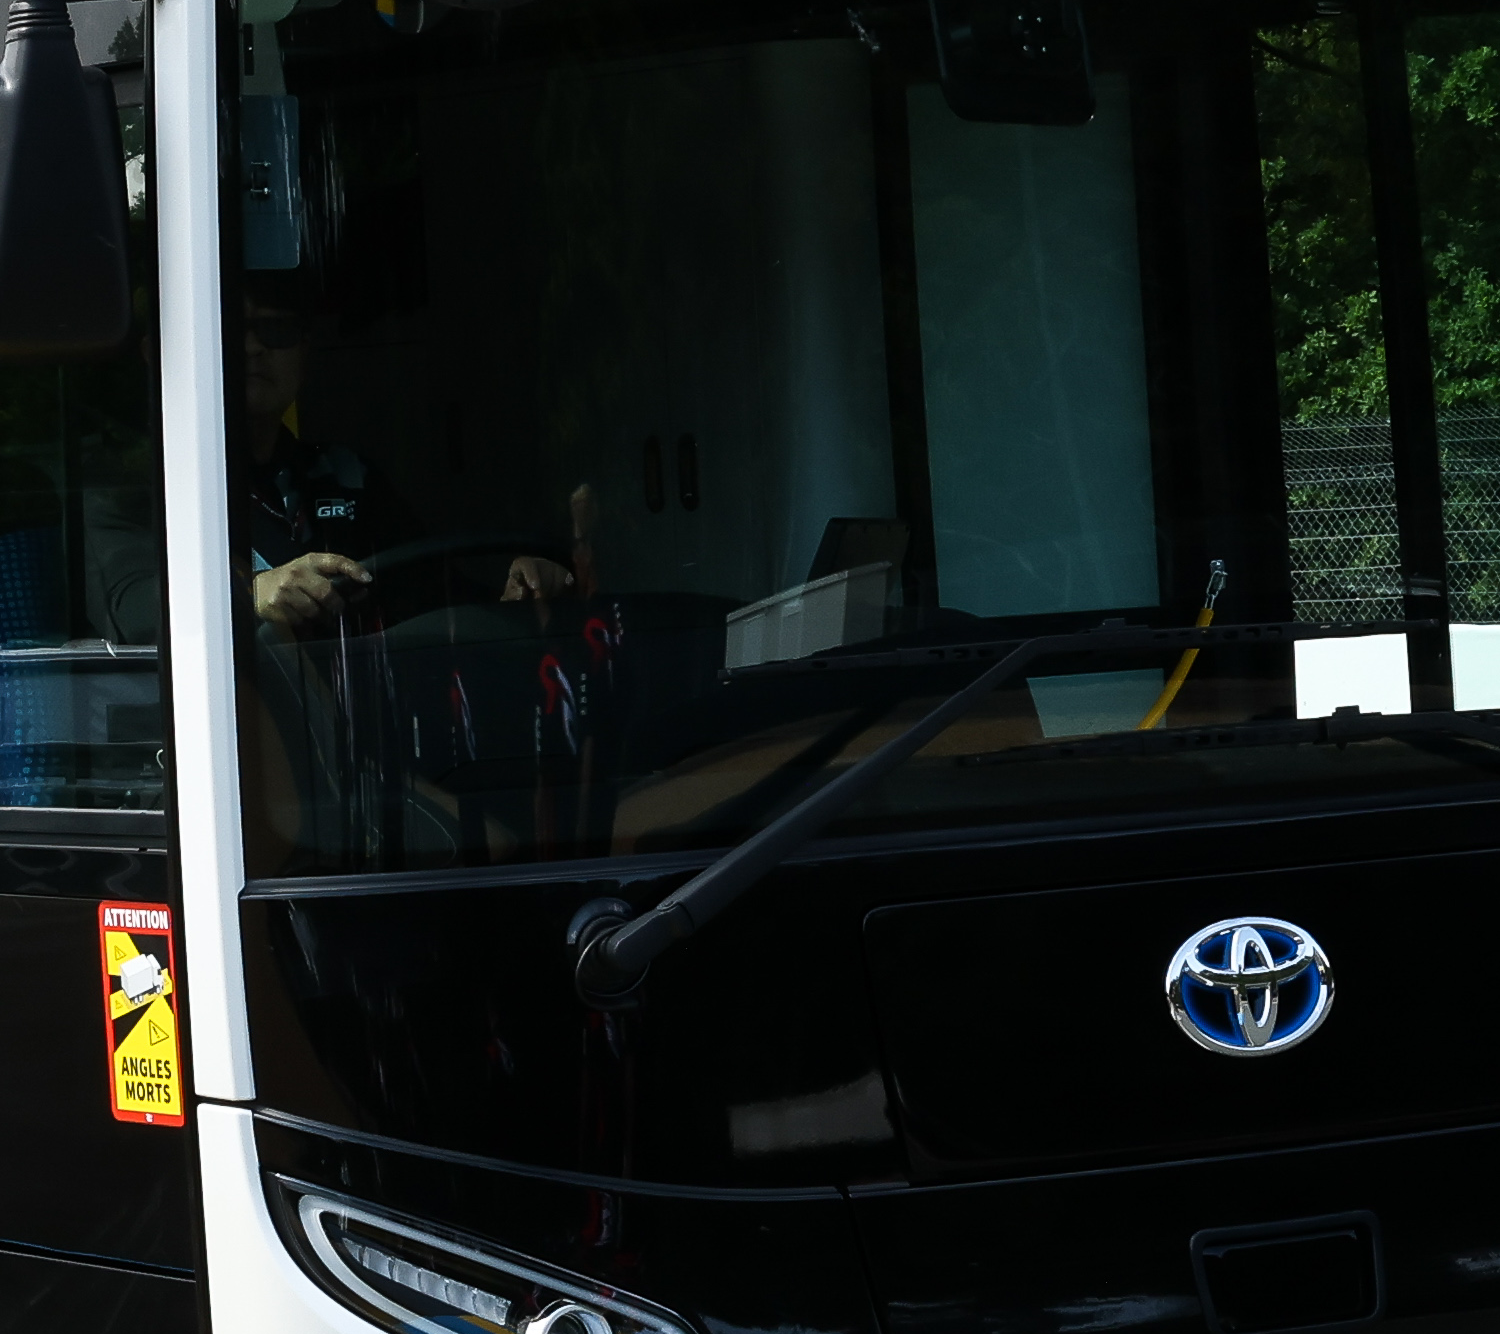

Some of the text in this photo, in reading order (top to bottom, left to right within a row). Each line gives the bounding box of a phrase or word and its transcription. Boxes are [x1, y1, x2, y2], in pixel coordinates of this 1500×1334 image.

[103, 907, 169, 930] ATTENTION
[121, 1056, 172, 1080] ANGLES
[125, 1080, 171, 1104] MORTS
